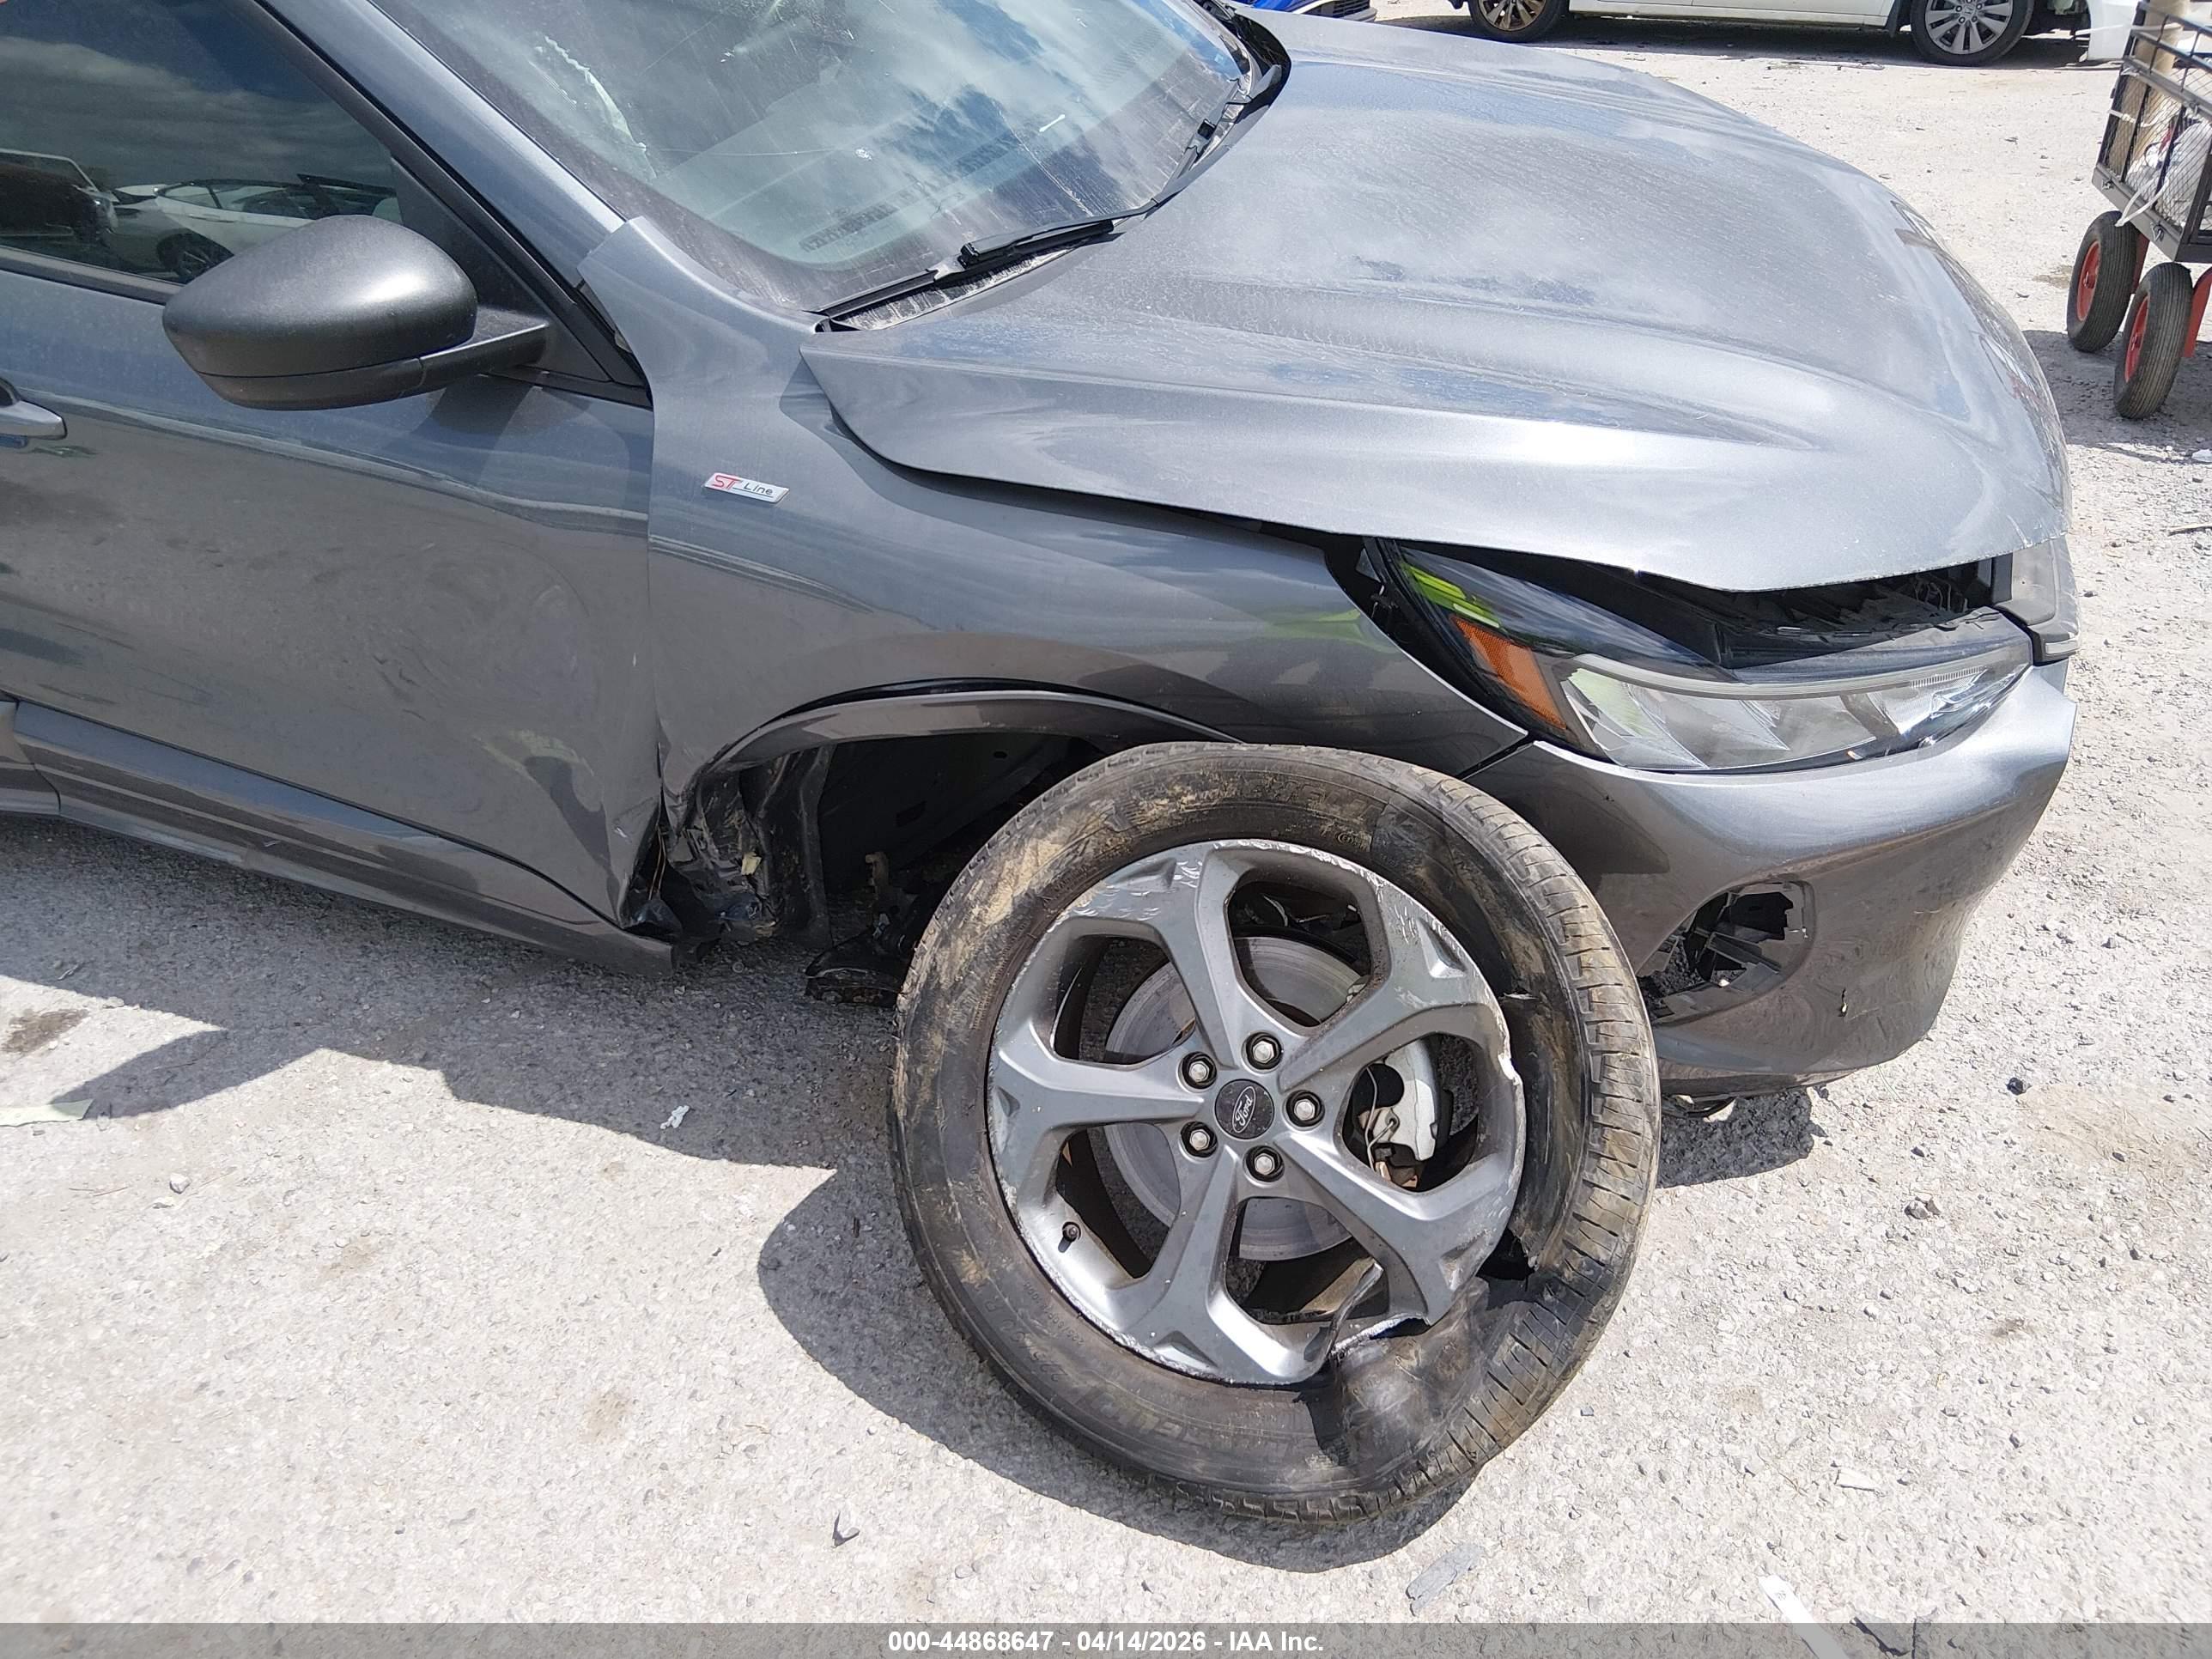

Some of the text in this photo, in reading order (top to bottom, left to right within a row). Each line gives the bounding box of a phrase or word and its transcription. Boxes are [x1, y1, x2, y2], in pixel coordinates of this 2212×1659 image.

[712, 475, 773, 495] ST Line
[1236, 1095, 1253, 1126] Ford
